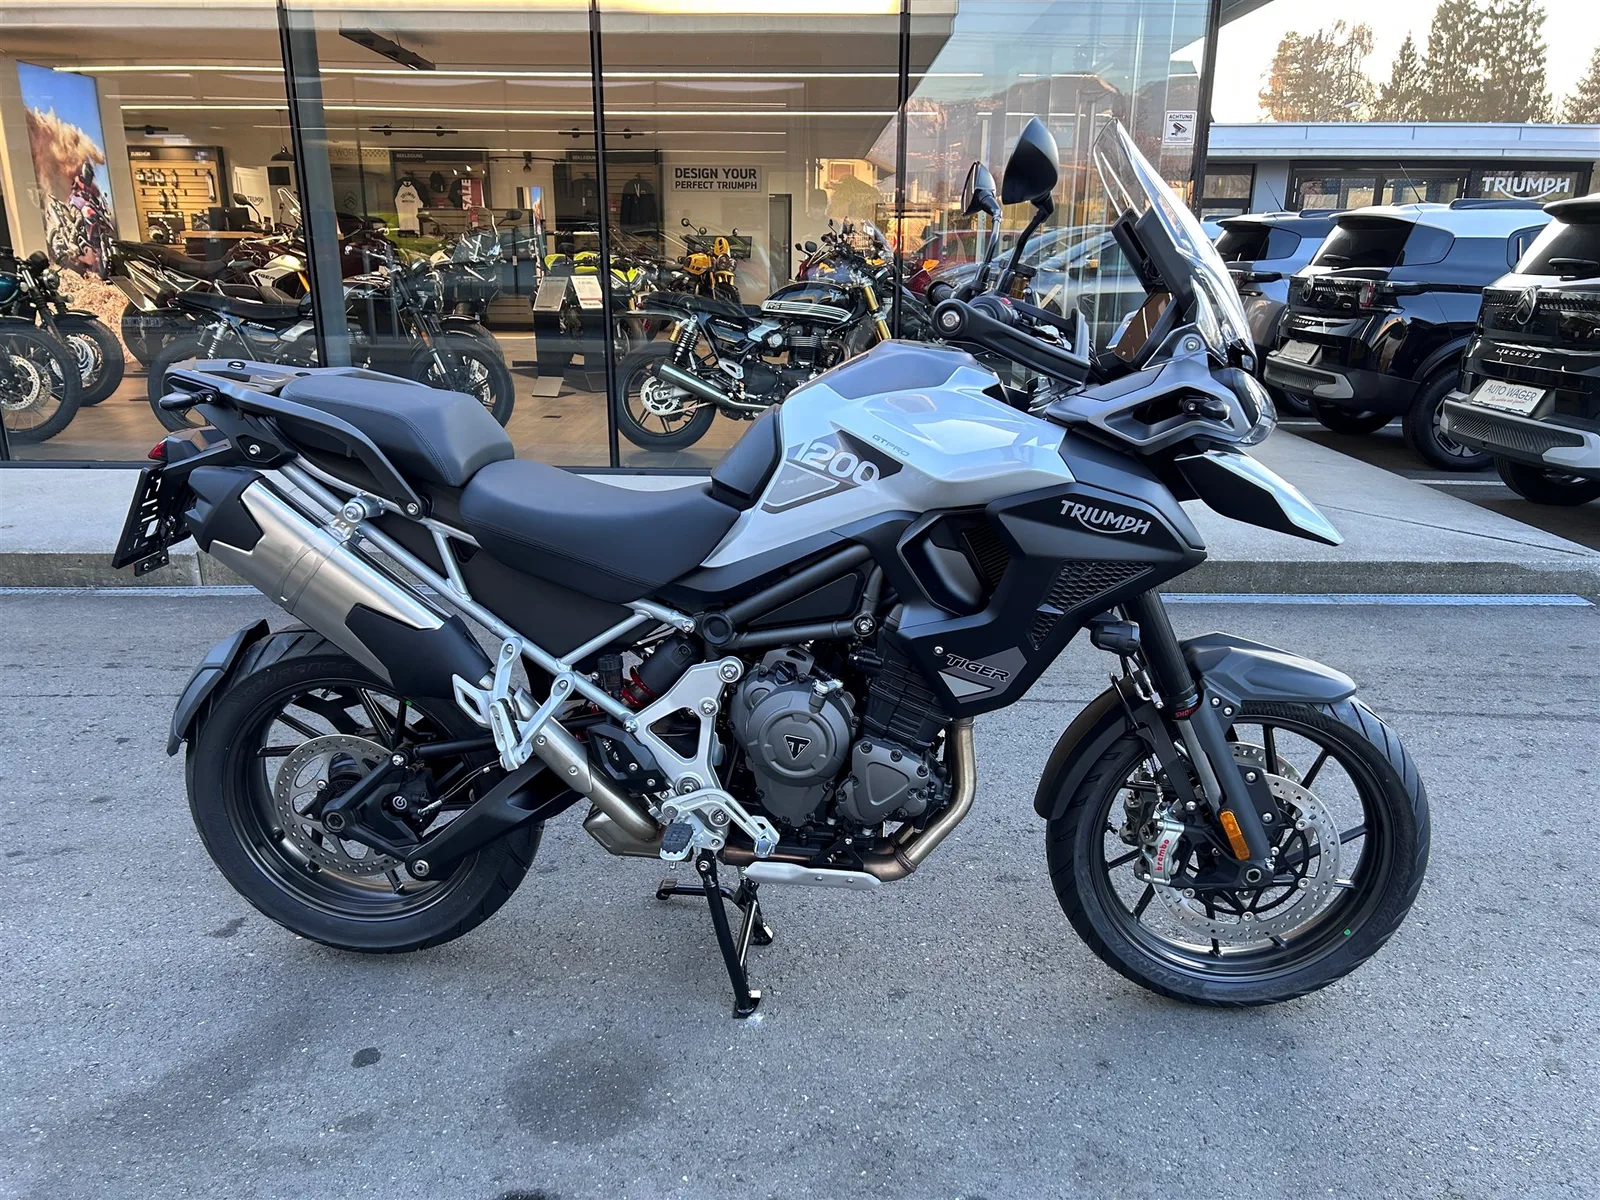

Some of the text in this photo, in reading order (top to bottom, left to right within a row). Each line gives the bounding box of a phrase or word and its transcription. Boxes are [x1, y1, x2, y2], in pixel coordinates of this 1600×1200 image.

[674, 180, 758, 190] PERFECT TRIUMPH
[675, 167, 758, 180] DESIGN YOUR
[461, 178, 473, 211] SALE
[1481, 176, 1571, 200] TRIUMPH
[254, 271, 276, 281] TIGER
[1484, 383, 1508, 397] AUTO
[793, 441, 880, 487] 1200
[1060, 499, 1152, 535] TRIUMPH
[946, 652, 1011, 683] TIGER
[1154, 838, 1170, 872] brembo
